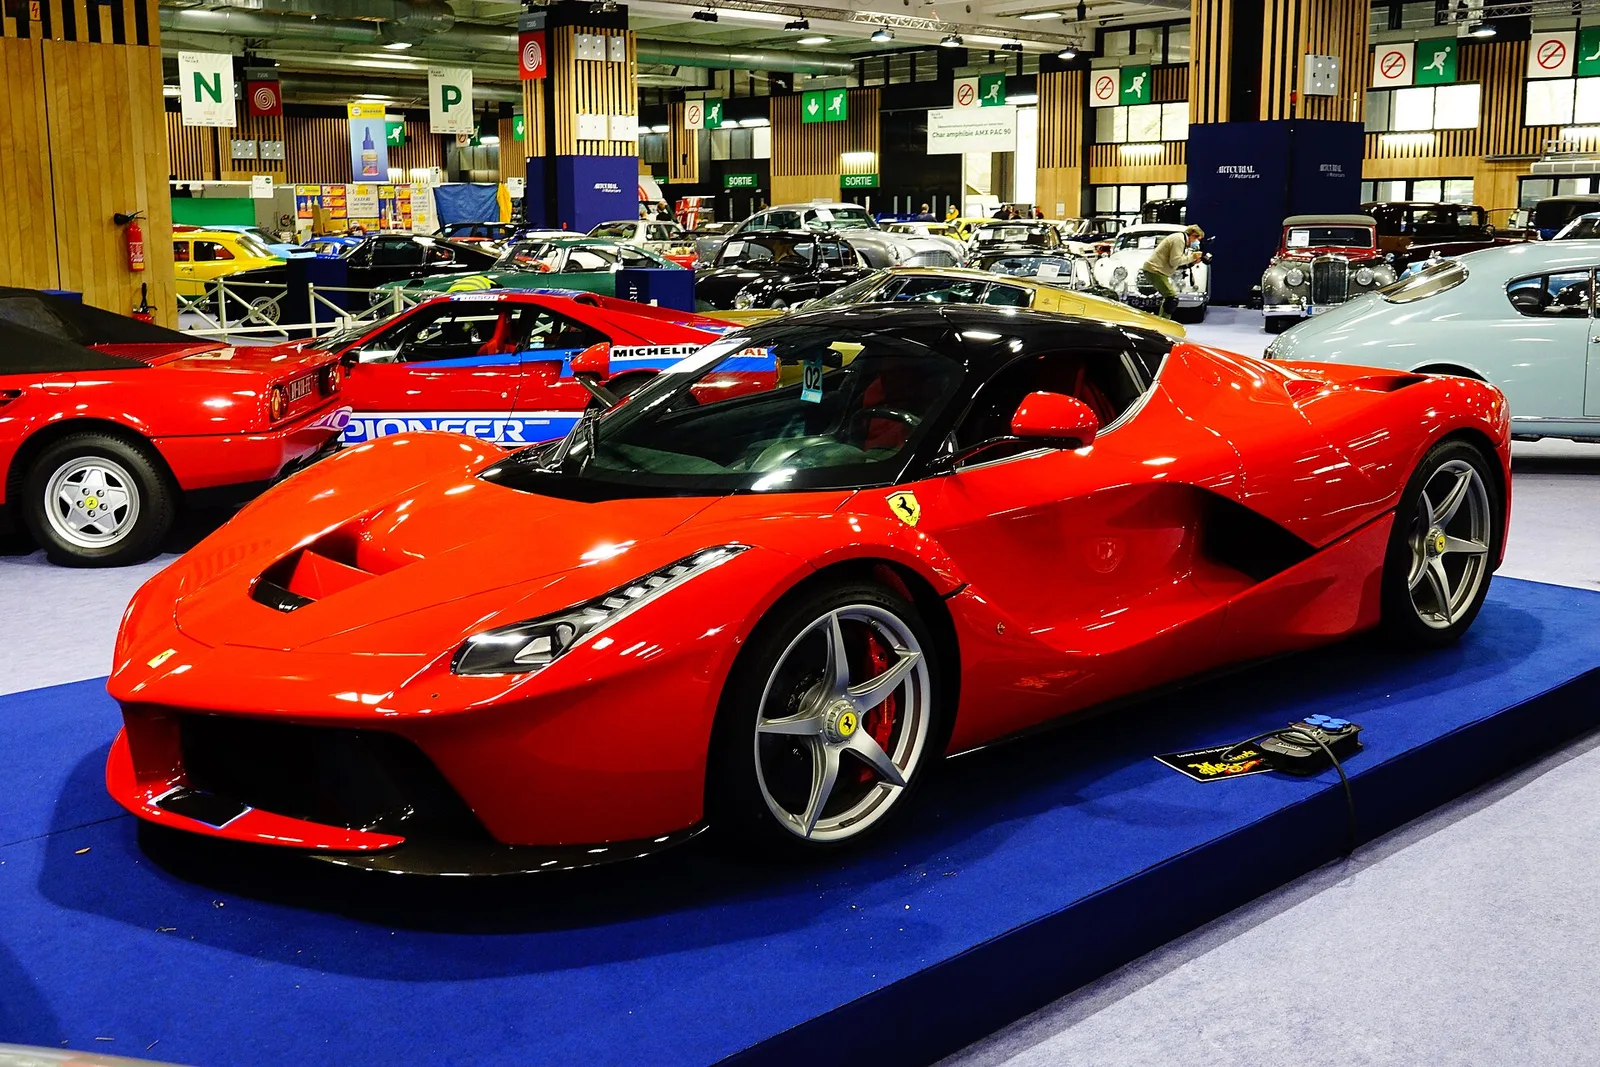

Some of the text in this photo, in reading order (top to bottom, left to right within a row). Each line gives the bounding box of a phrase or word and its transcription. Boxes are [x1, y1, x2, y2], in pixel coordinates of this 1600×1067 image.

[193, 71, 222, 103] N
[441, 85, 462, 113] P
[946, 130, 974, 138] amphibie
[1216, 165, 1255, 173] ARTCURIAL
[728, 176, 752, 186] SORTIE
[845, 176, 872, 186] SORTIE
[613, 347, 700, 358] MICHELIN
[805, 366, 821, 390] 02
